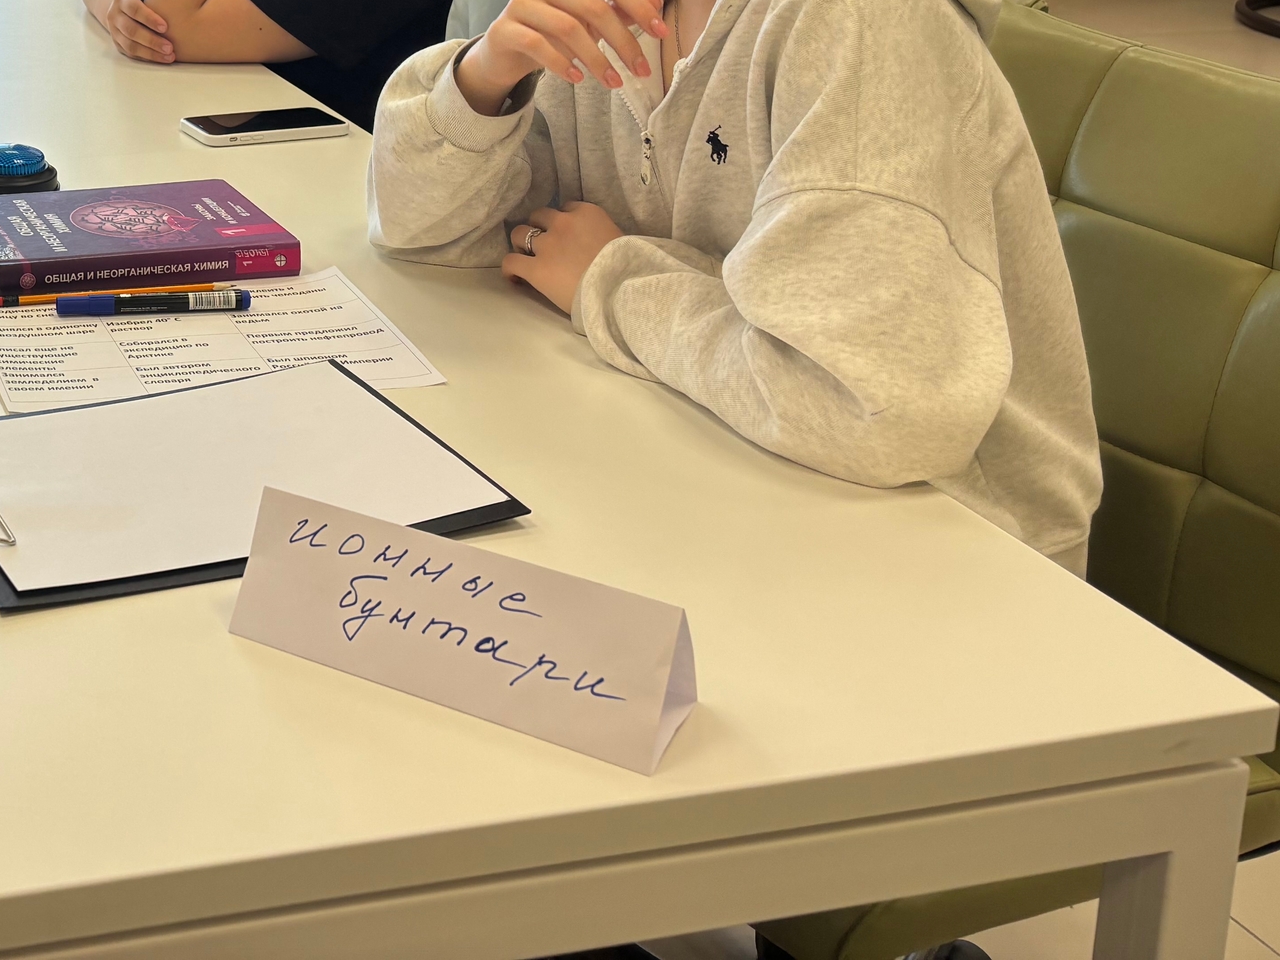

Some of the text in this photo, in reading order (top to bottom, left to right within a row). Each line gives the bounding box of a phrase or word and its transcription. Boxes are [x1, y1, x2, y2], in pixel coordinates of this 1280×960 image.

[44, 260, 229, 284] ОБЩАЯ И НЕОРГАНИЧЕСКАЯ ХИМИЯ
[271, 287, 327, 298] чемоданы
[231, 310, 289, 319] Занимался
[291, 306, 327, 315] охотой
[45, 323, 98, 331] одиночку
[106, 319, 153, 327] Изобрел
[110, 325, 153, 333] раствор
[246, 325, 358, 339] Первым предложил
[0, 331, 64, 339] воздушном
[251, 328, 385, 345] построить нефтепровод
[119, 338, 179, 347] Собирался
[123, 343, 193, 353] экспедицию
[127, 352, 174, 360] Арктике
[267, 353, 348, 364] Был шпионом
[339, 356, 394, 365] Империи
[162, 362, 212, 371] автором
[139, 365, 261, 379] энциклопедического
[5, 378, 87, 386] земледелием
[144, 377, 192, 386] словаря
[288, 518, 543, 618] ионные
[338, 575, 627, 701] бунтари
